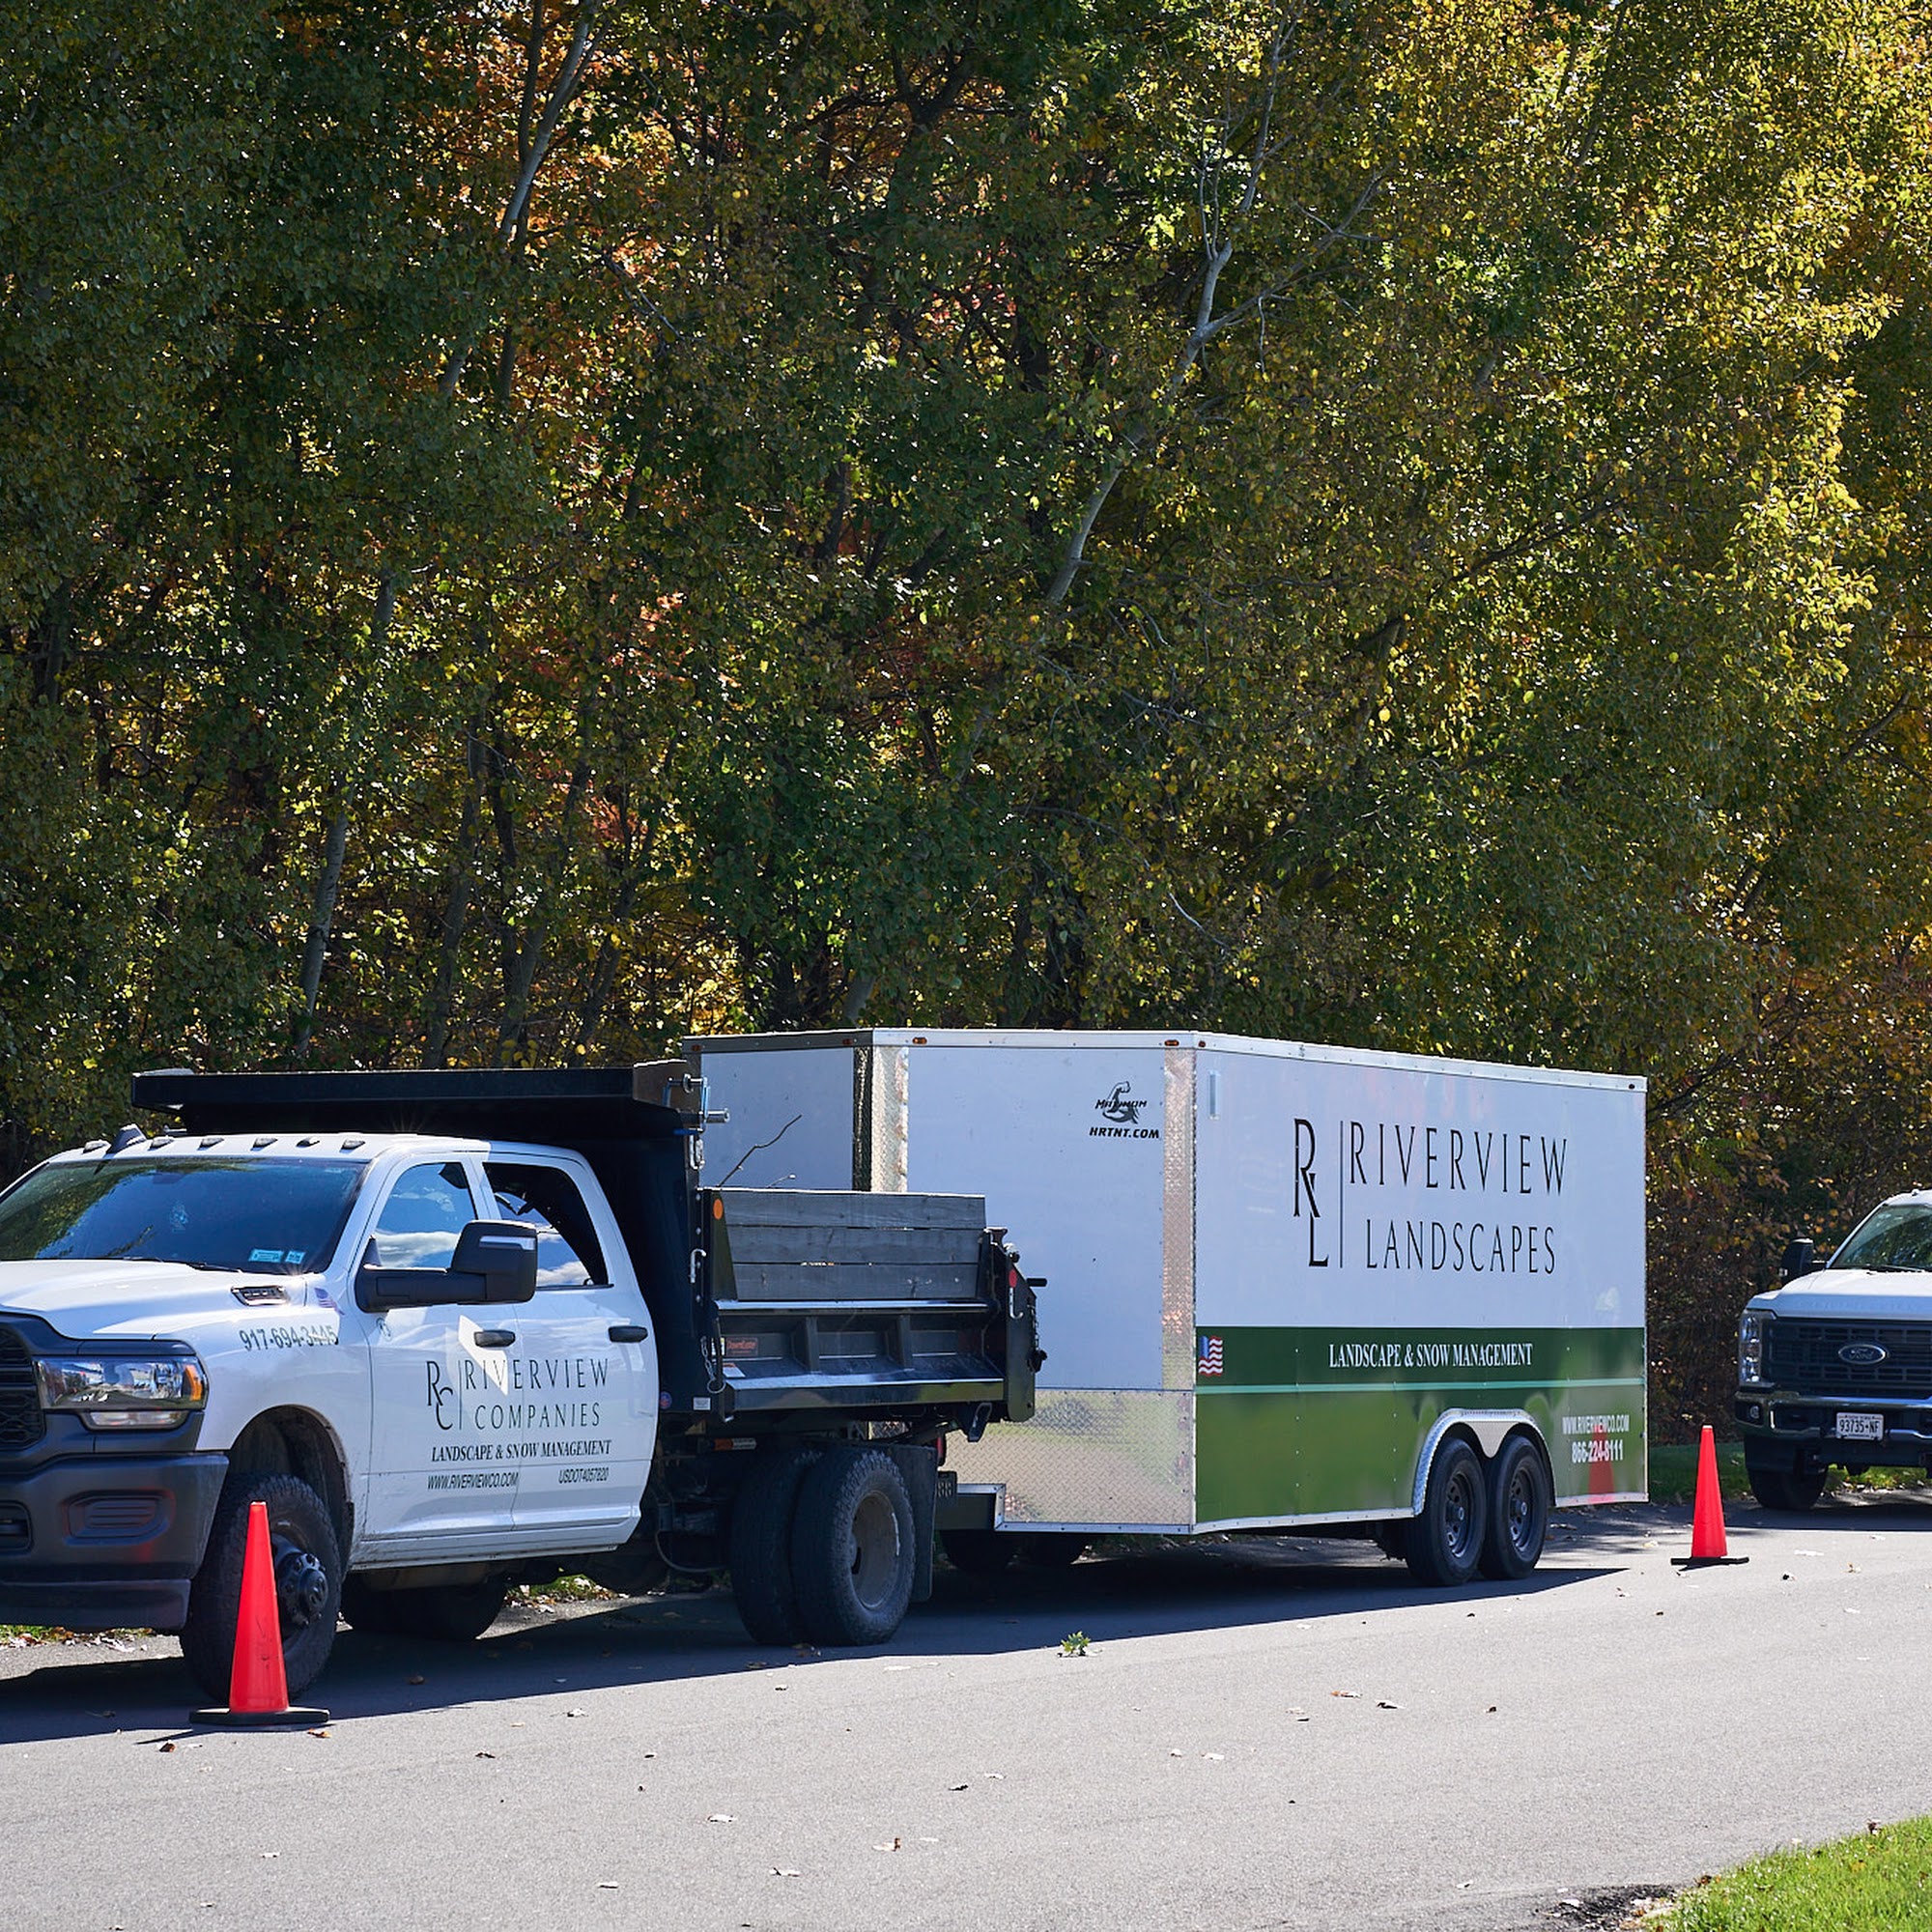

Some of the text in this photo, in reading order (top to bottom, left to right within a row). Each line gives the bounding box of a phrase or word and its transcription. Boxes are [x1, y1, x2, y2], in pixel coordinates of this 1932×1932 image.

[1089, 1126, 1159, 1139] HRTNT.COM
[1350, 1121, 1567, 1196] RIVERVIEW
[1366, 1218, 1556, 1274] LANDSCAPES
[1329, 1343, 1534, 1368] LANDSCAPE & SNOW MANAGEMENT
[465, 1357, 609, 1390] RIVERVIEW
[474, 1402, 601, 1430] COMPANIES
[431, 1439, 612, 1463] LANDSCAPE & SNOW MANAGEMENT
[428, 1471, 520, 1490] WWW.RIVERVIEWCO.COM
